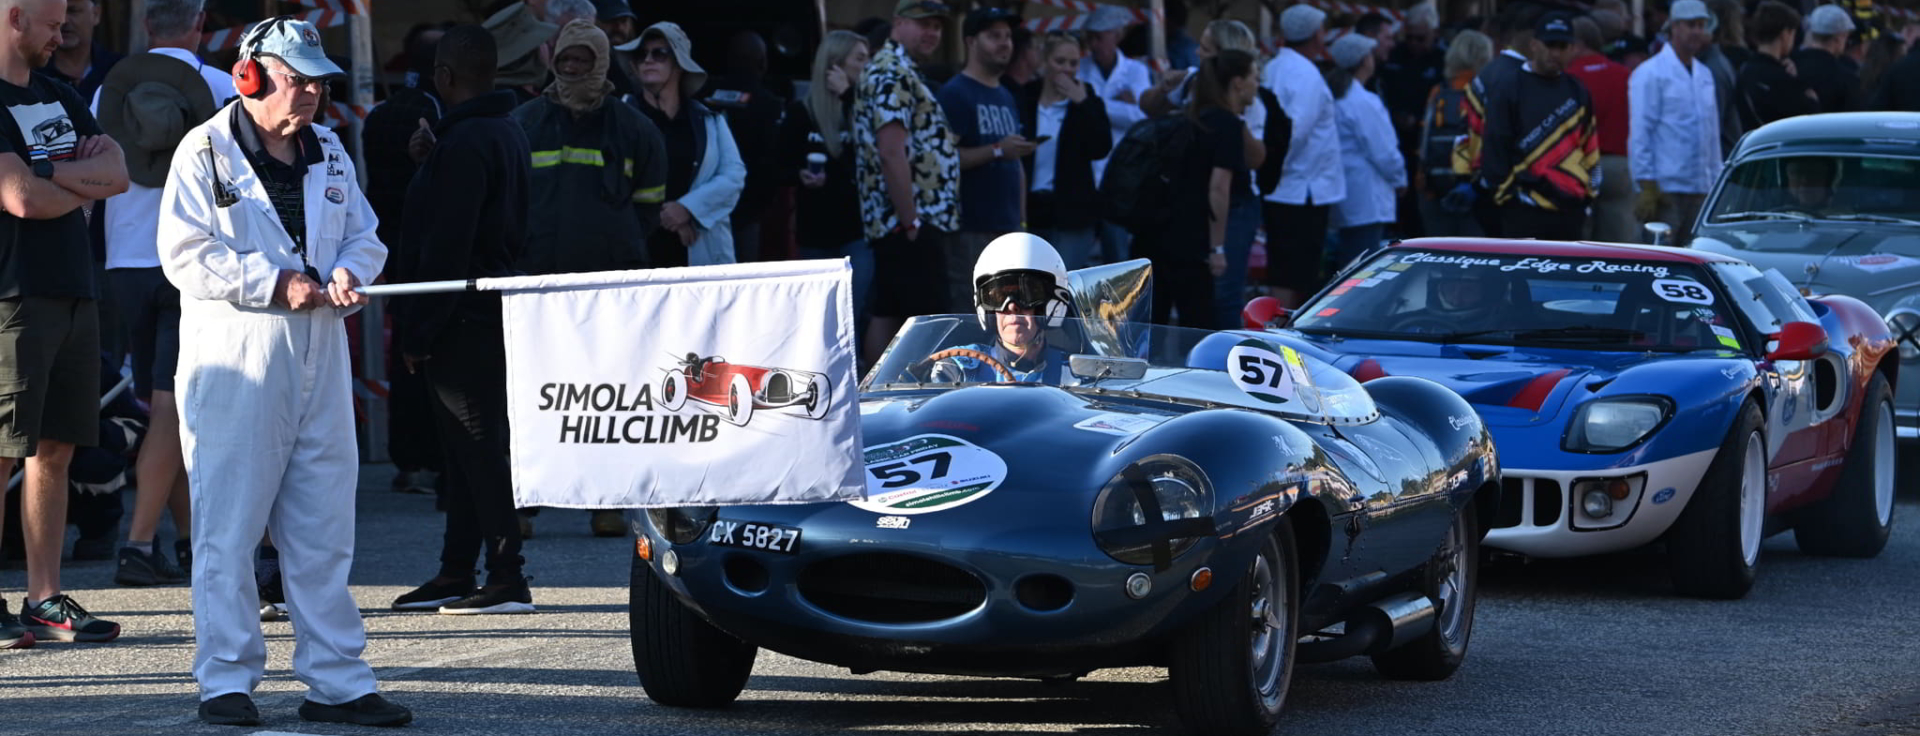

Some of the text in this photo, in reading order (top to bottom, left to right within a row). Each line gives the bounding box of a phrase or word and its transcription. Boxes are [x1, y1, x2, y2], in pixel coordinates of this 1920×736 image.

[976, 103, 1016, 136] BRO
[1400, 252, 1670, 278] Classique Edge Racing
[1660, 284, 1708, 301] 58
[1238, 355, 1283, 389] 57
[538, 382, 654, 412] SIMOLA
[559, 414, 721, 444] HILLCLIMB
[868, 451, 953, 488] 57
[711, 520, 799, 552] CX 5827
